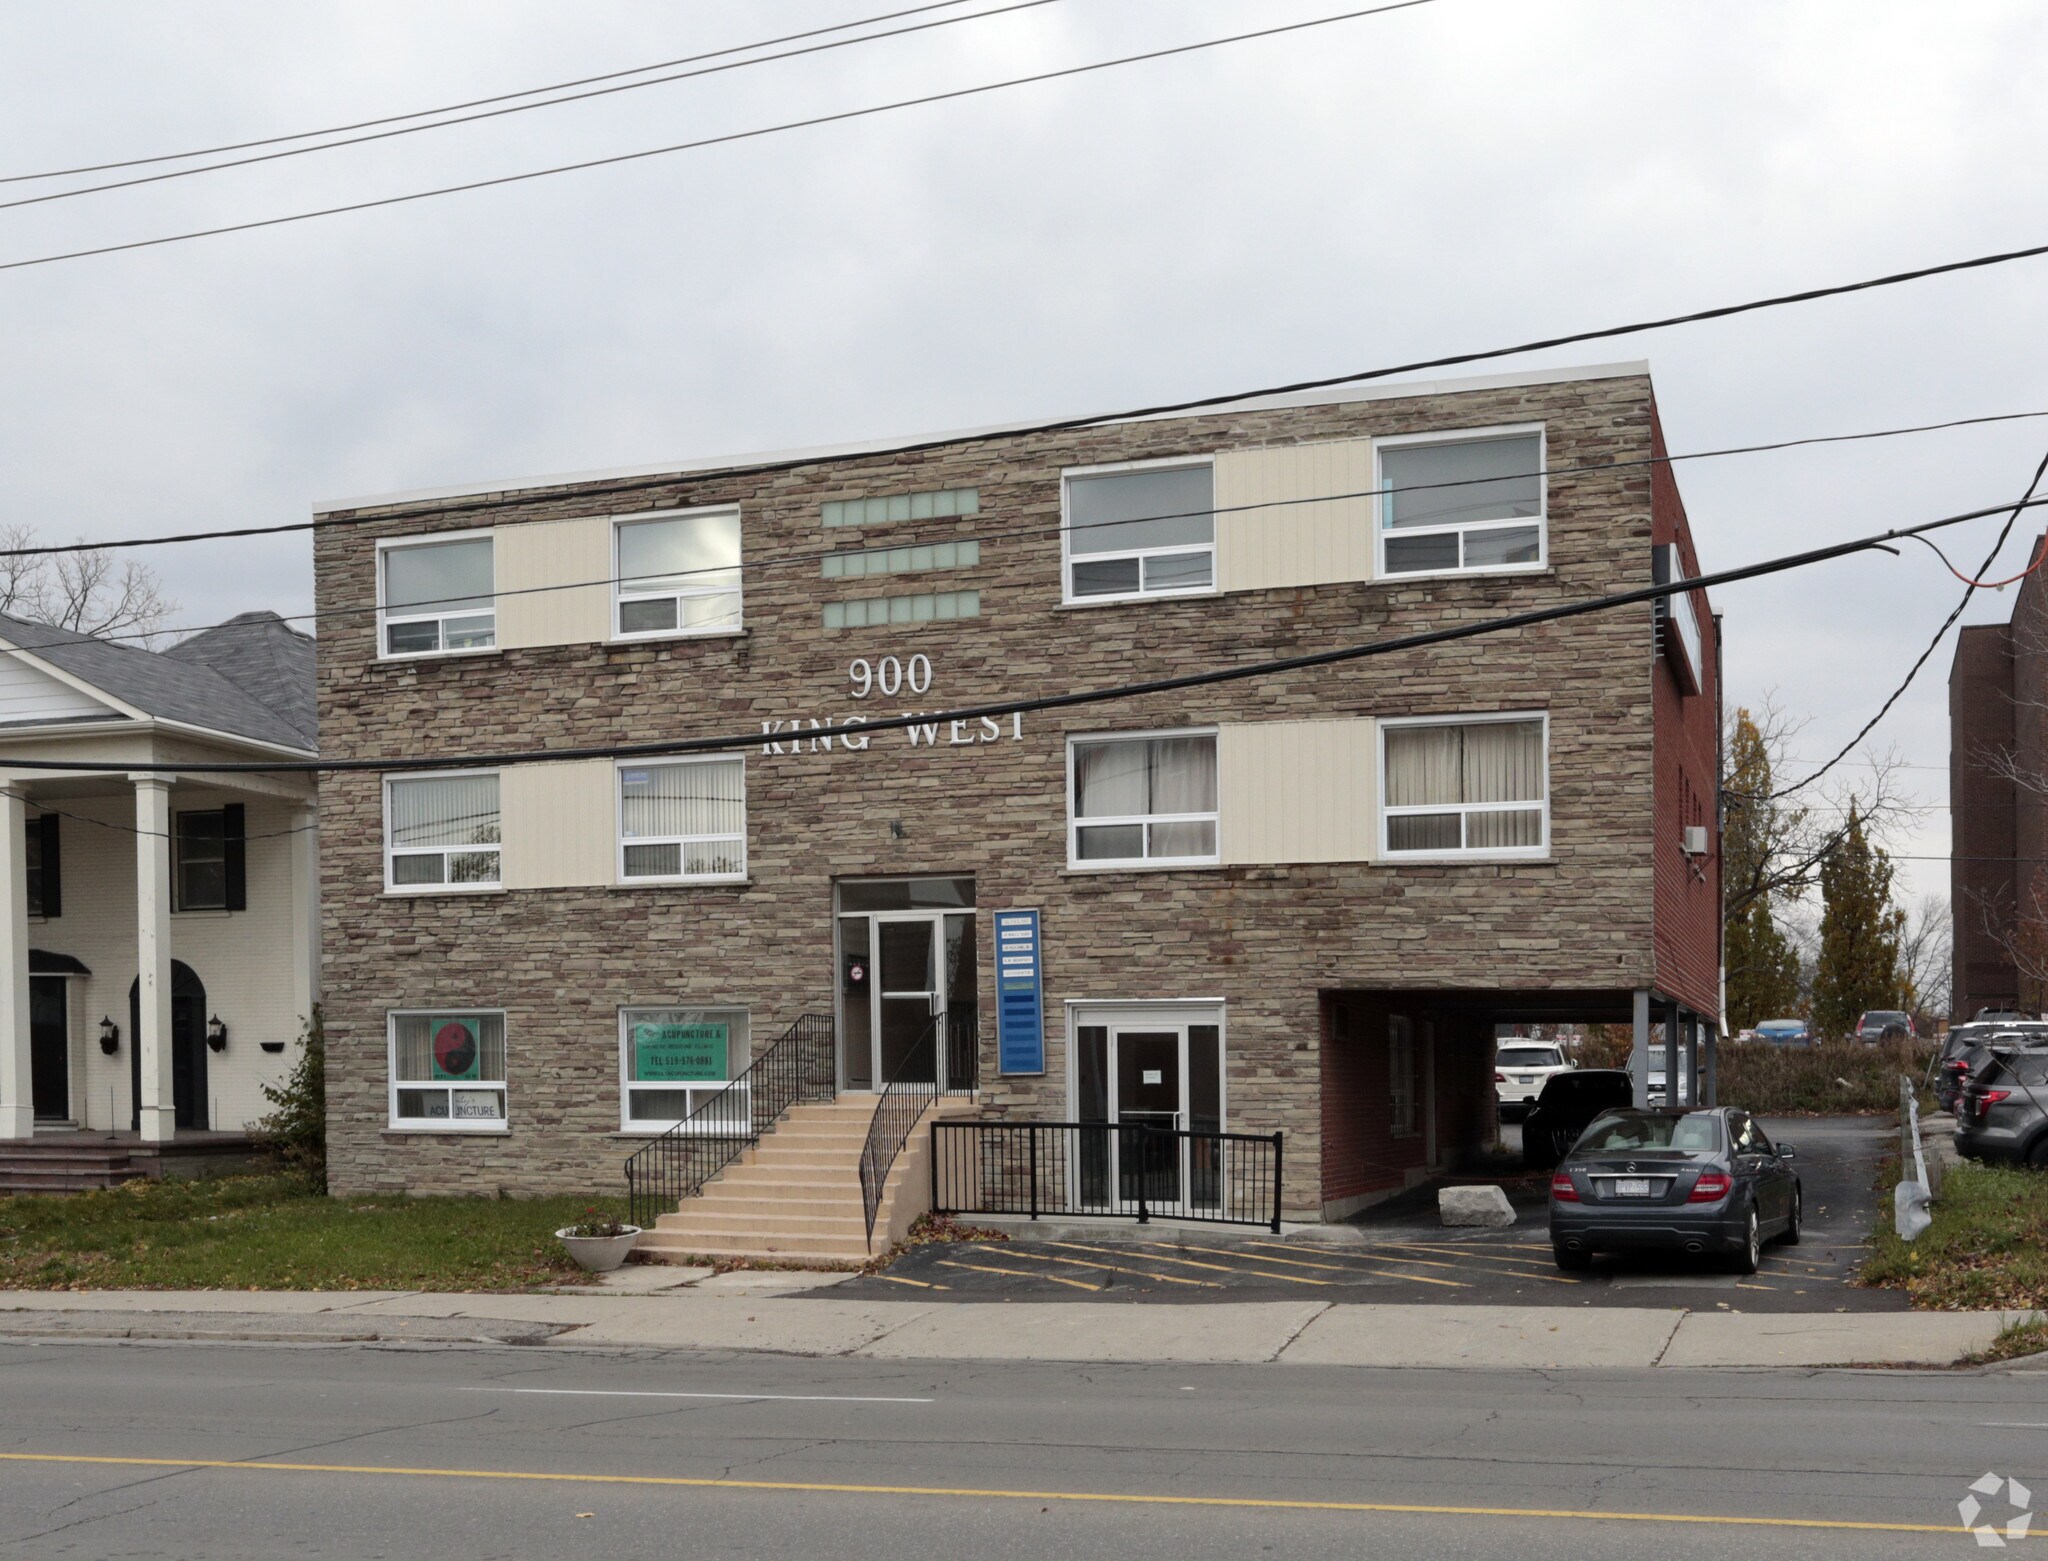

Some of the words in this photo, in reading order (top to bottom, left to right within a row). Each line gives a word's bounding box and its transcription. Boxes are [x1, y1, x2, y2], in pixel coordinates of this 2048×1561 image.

[850, 653, 932, 698] 900
[760, 715, 871, 756] KING
[901, 710, 1024, 747] WEST
[662, 1029, 713, 1040] ACUPUNCTURE
[715, 1029, 721, 1039] &
[430, 1105, 495, 1117] ACUUNCTURE
